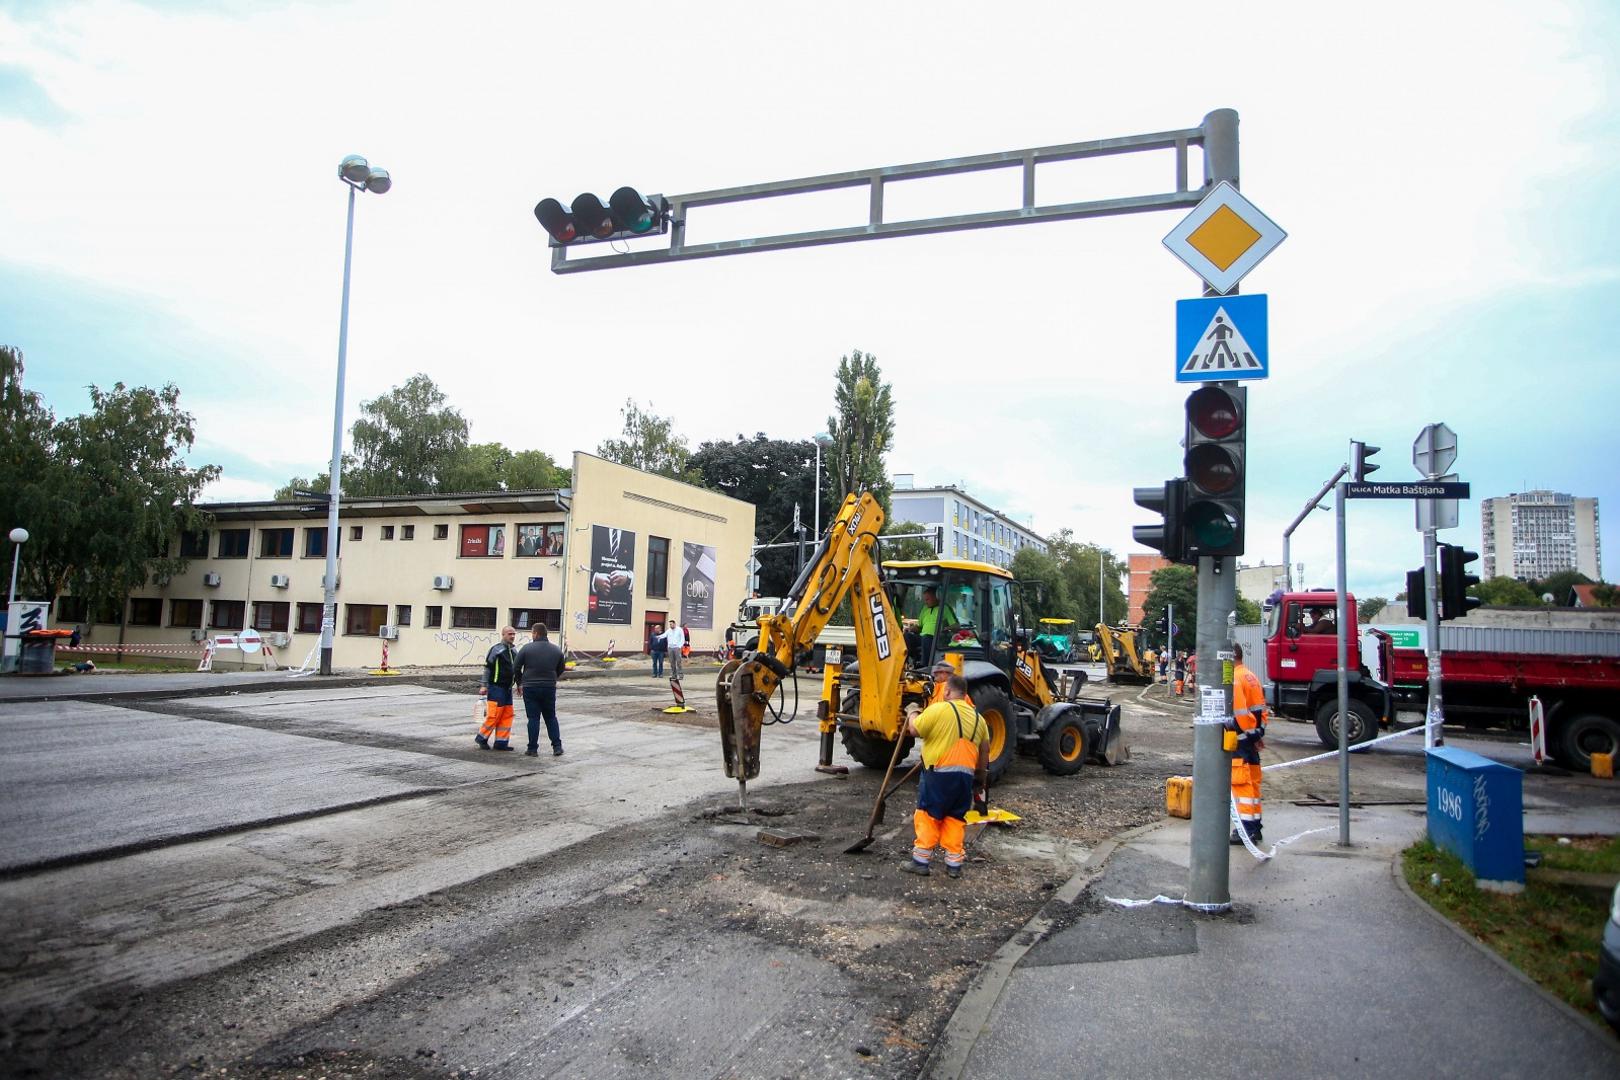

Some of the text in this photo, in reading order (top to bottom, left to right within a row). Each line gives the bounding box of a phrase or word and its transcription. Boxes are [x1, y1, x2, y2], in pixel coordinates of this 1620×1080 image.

[1373, 485, 1400, 494] Matka
[1402, 485, 1444, 495] Baštijana
[870, 596, 890, 660] JCB
[1437, 786, 1462, 821] 1986
